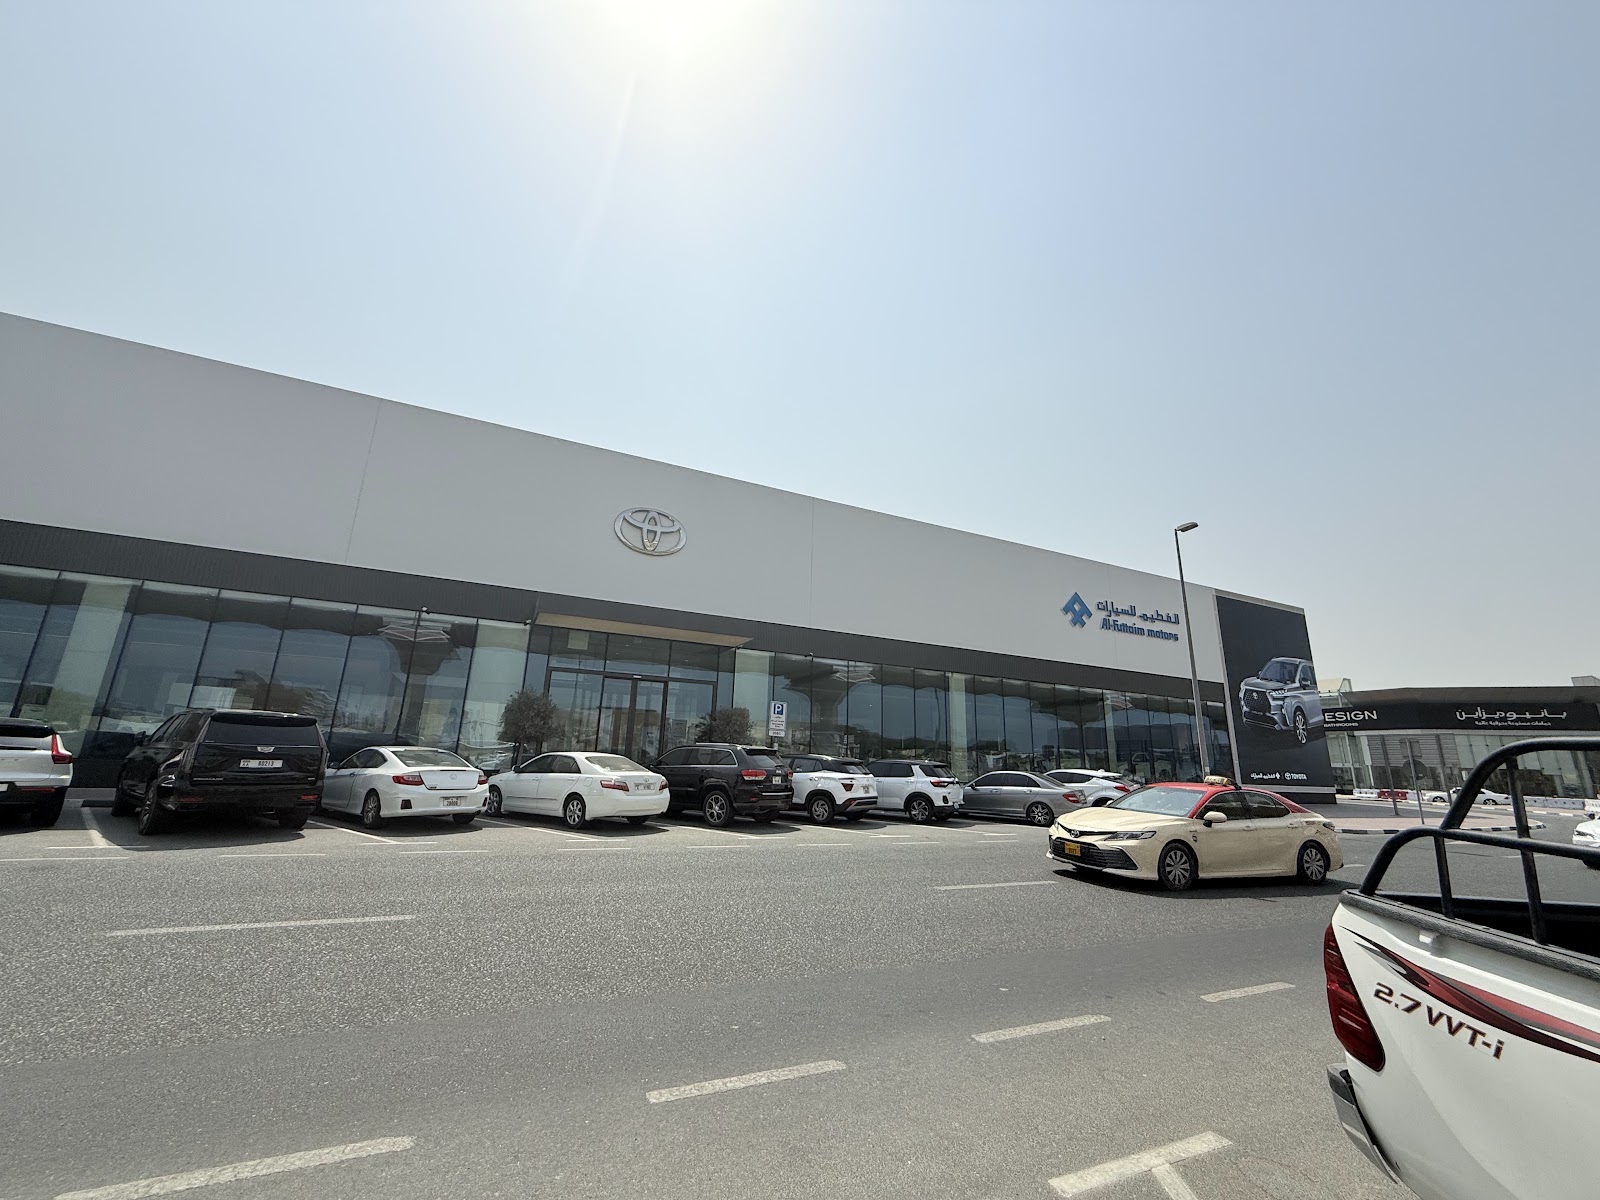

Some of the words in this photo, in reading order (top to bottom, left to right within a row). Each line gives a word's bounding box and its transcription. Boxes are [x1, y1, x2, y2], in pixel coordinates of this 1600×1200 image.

[1096, 600, 1137, 617] للسيارات
[1137, 609, 1180, 625] الفطيم
[1101, 618, 1145, 636] Al-Futtaim
[1146, 629, 1179, 641] motors
[775, 704, 782, 714] P
